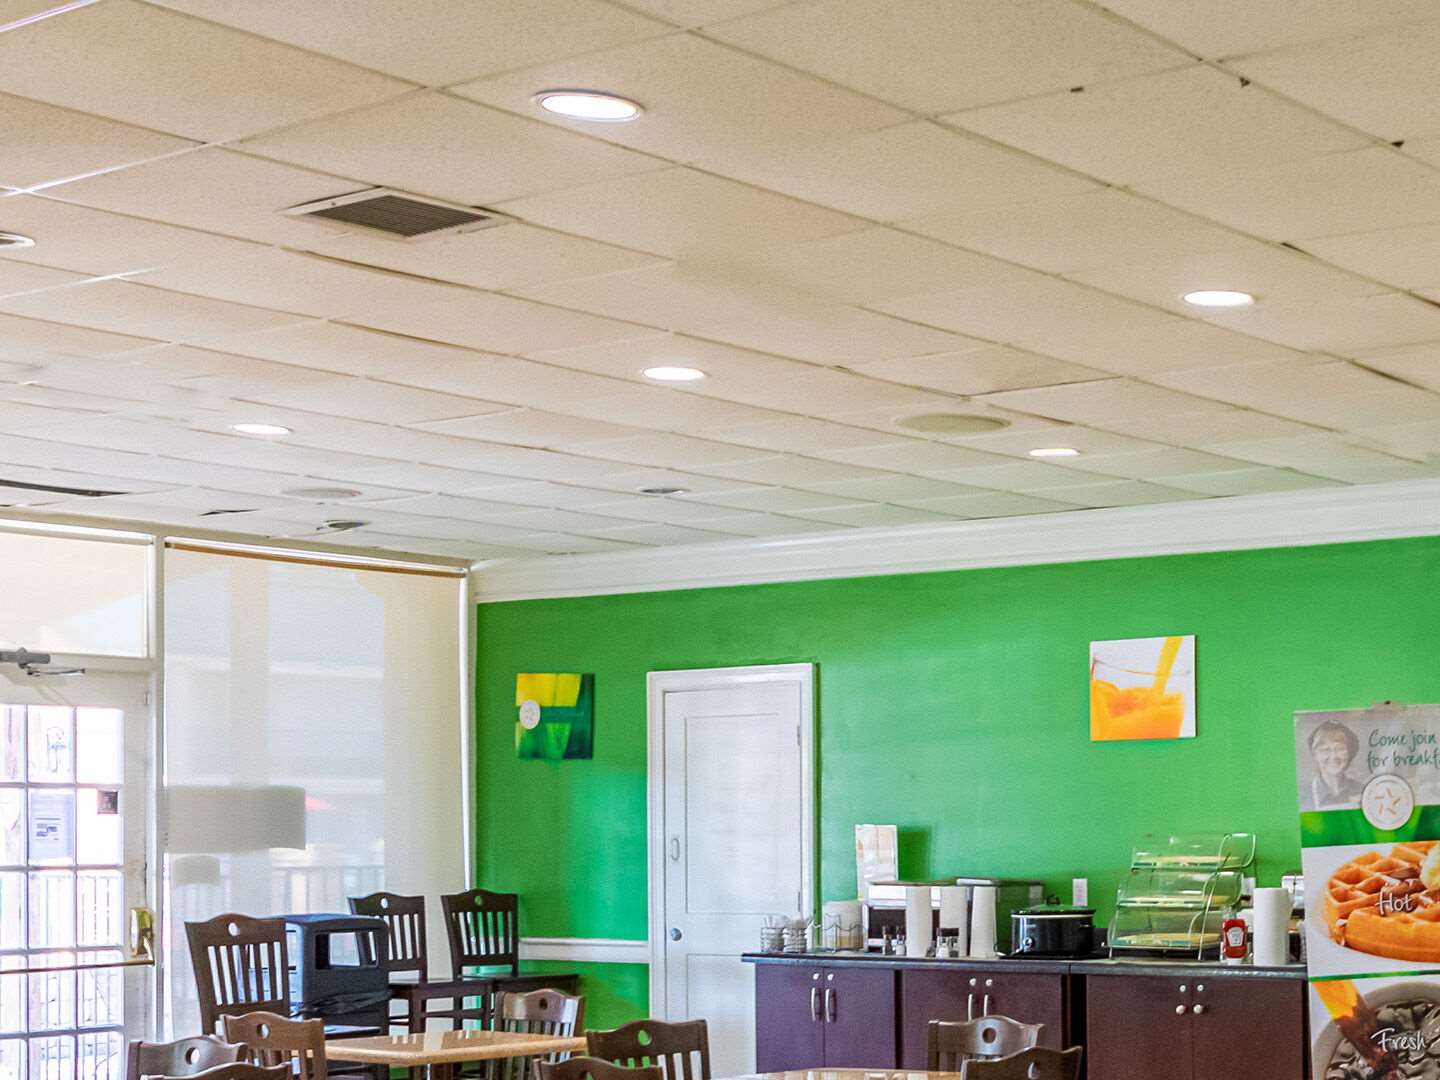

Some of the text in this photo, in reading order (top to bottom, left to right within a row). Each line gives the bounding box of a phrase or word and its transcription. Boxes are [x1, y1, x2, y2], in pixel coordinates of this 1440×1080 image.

[1368, 729, 1407, 747] Come
[1410, 730, 1437, 752] join
[1367, 751, 1388, 774] for
[1370, 890, 1413, 914] Hot
[1370, 1028, 1427, 1051] Fresh
